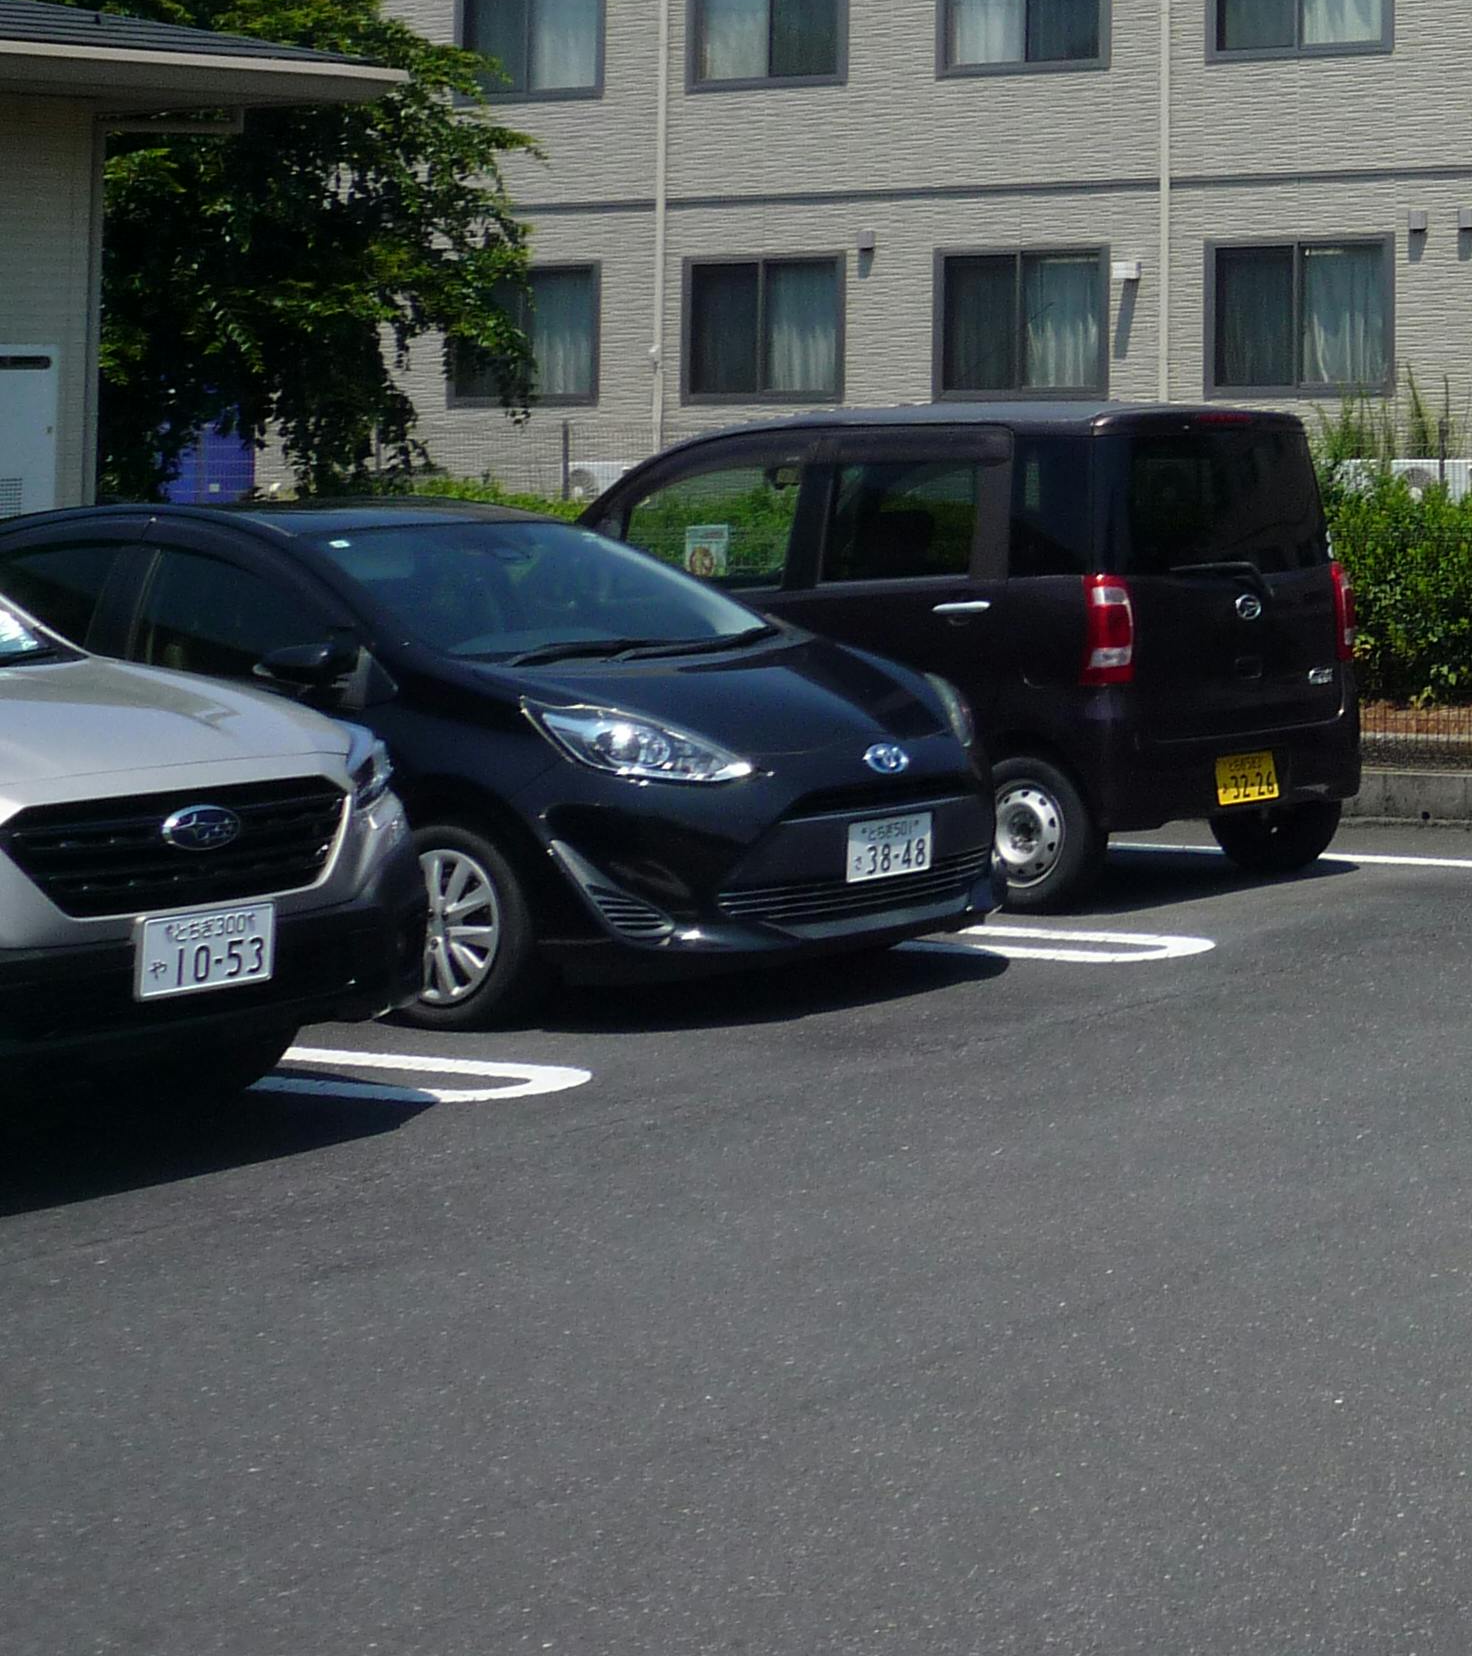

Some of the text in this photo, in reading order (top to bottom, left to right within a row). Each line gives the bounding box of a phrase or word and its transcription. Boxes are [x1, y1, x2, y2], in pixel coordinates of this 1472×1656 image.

[1230, 771, 1275, 799] 32-26
[866, 838, 926, 875] 38-48
[148, 935, 264, 986] や 10-53
